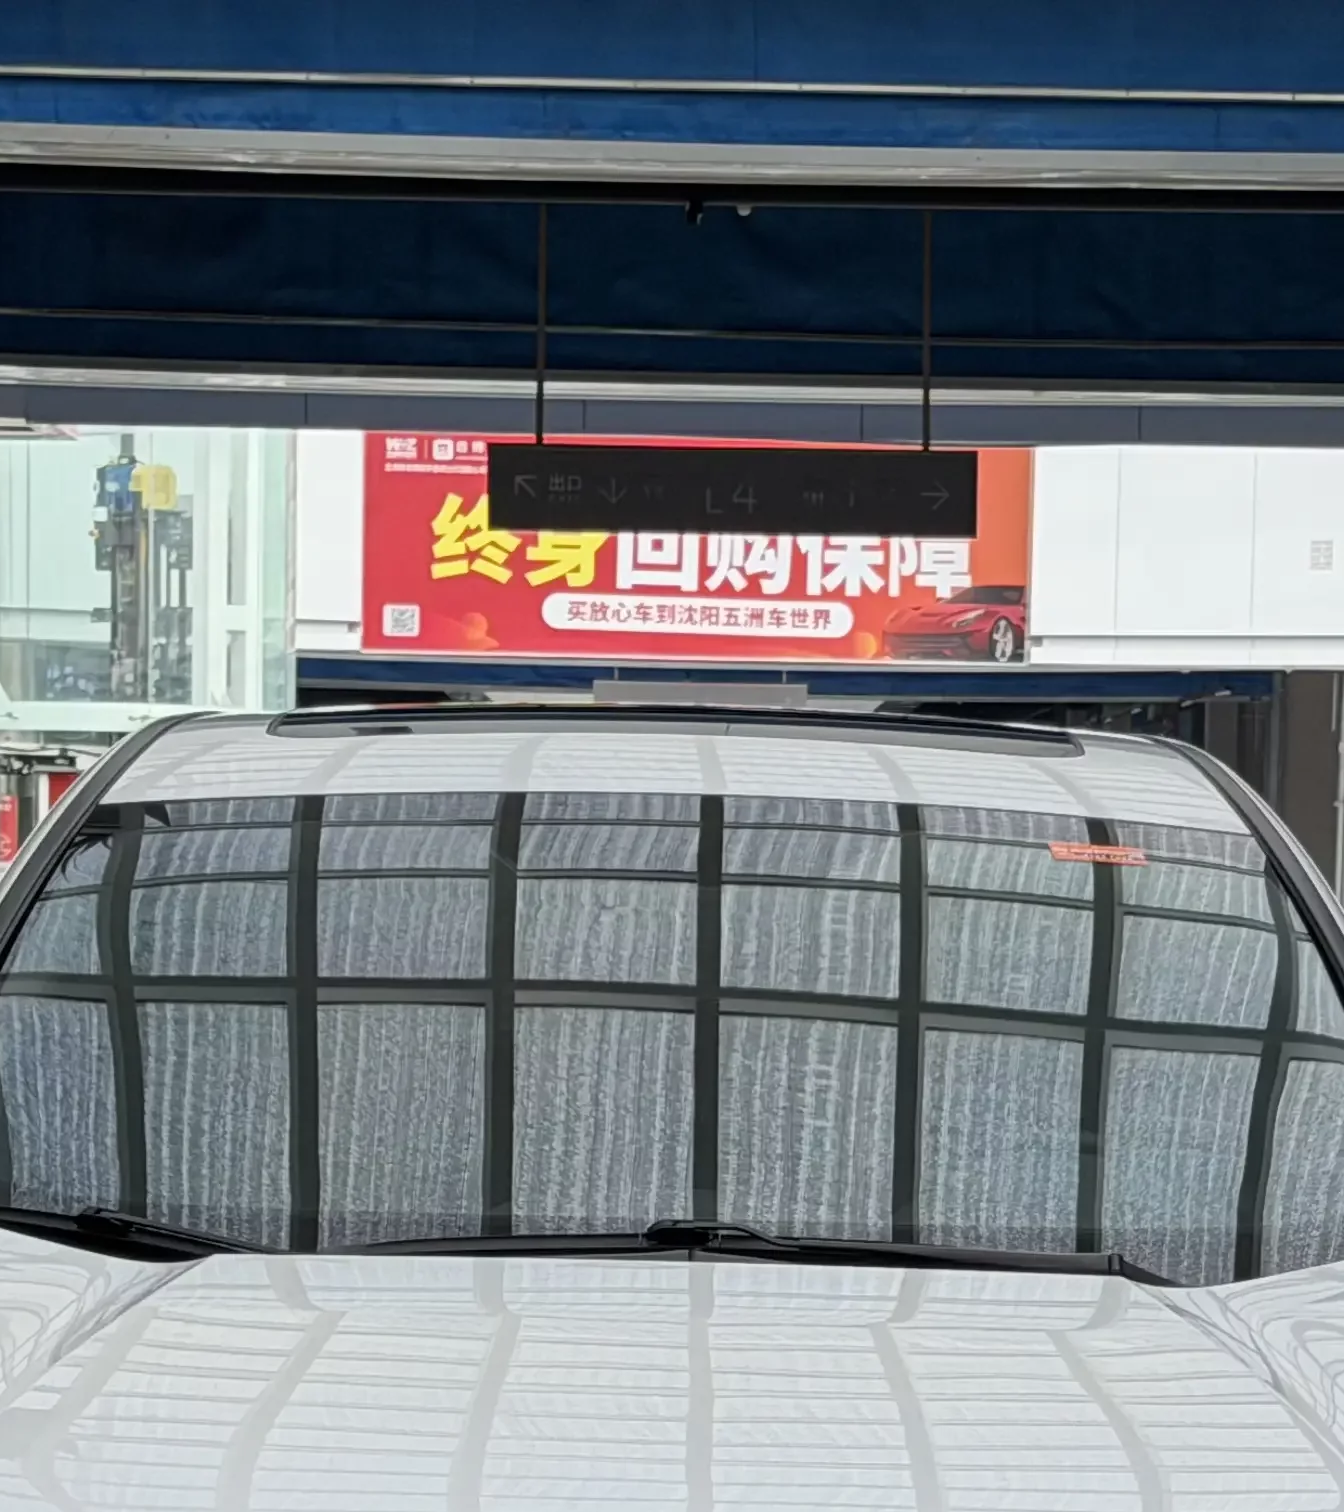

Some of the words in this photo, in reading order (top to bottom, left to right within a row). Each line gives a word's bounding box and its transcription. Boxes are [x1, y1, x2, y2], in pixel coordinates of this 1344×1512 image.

[430, 492, 973, 599] 终身回购保障
[566, 599, 833, 630] 买放心车到沈阳五洲车世界
